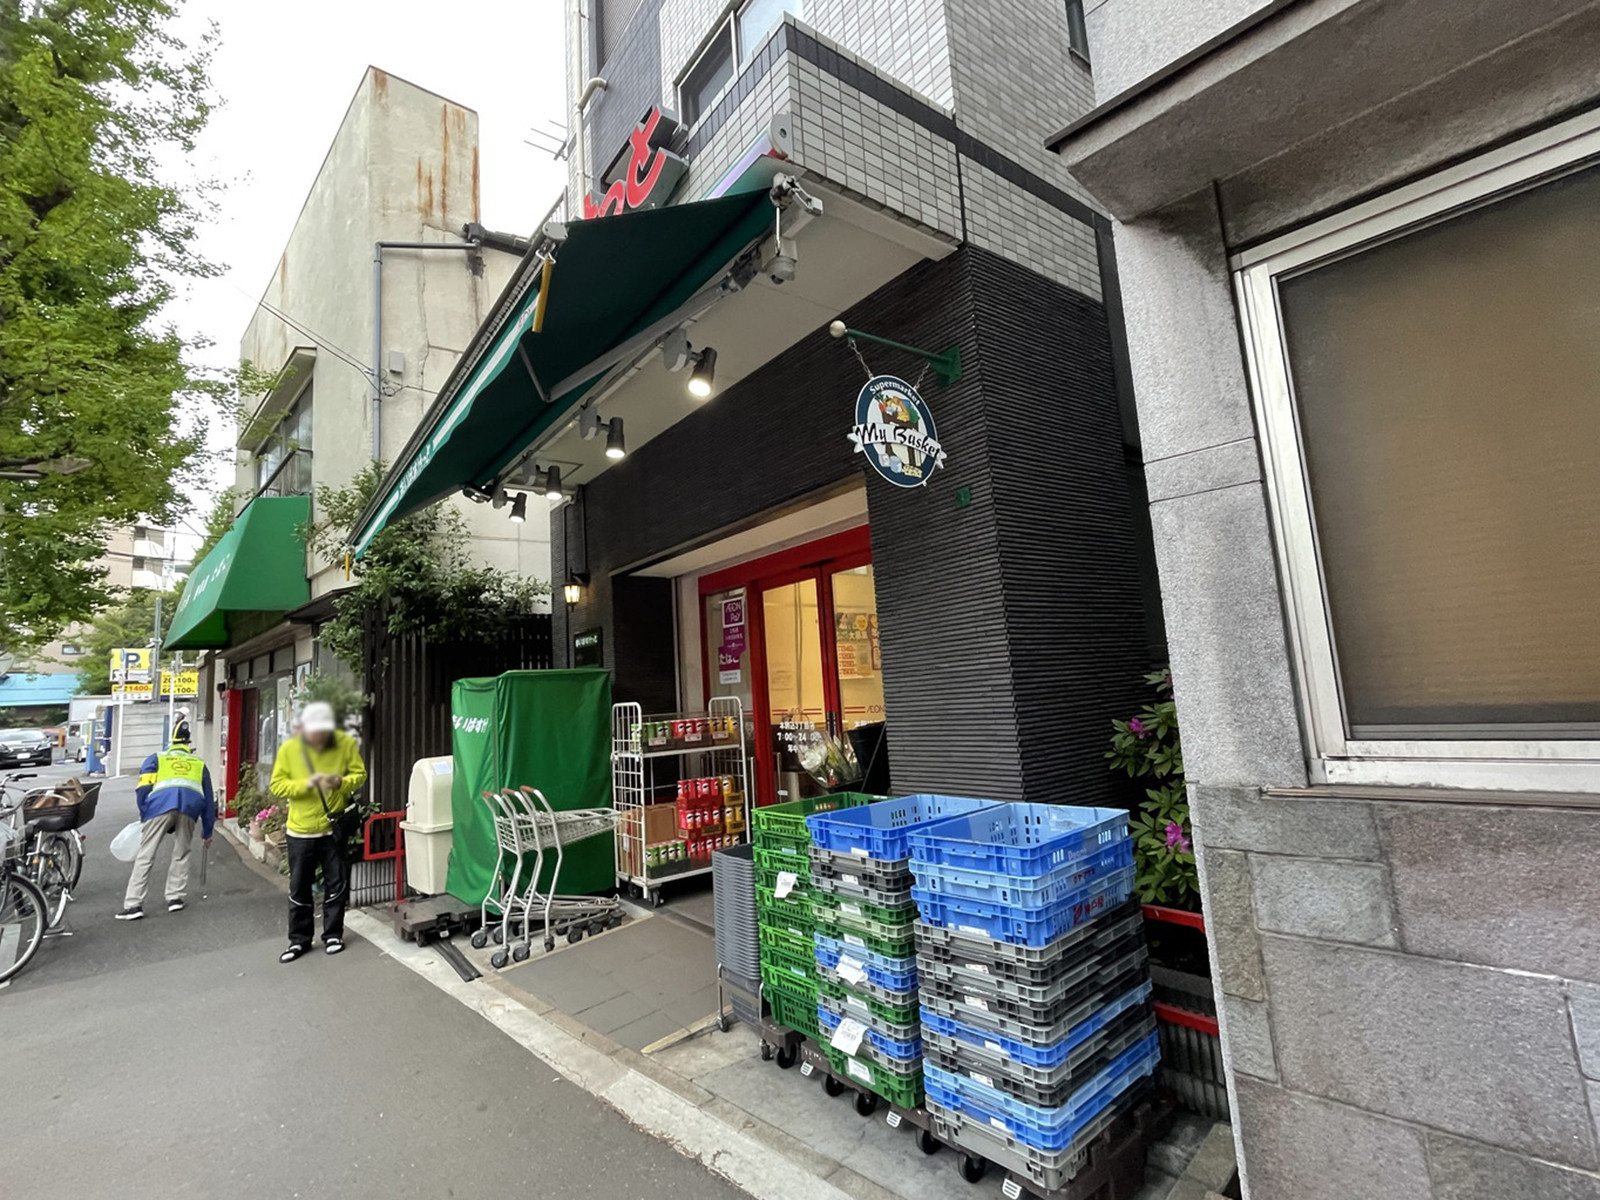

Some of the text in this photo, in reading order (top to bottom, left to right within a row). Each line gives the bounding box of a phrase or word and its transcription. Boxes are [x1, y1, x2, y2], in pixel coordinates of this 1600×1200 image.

[869, 381, 920, 406] Supermarket
[855, 423, 941, 458] My Basket
